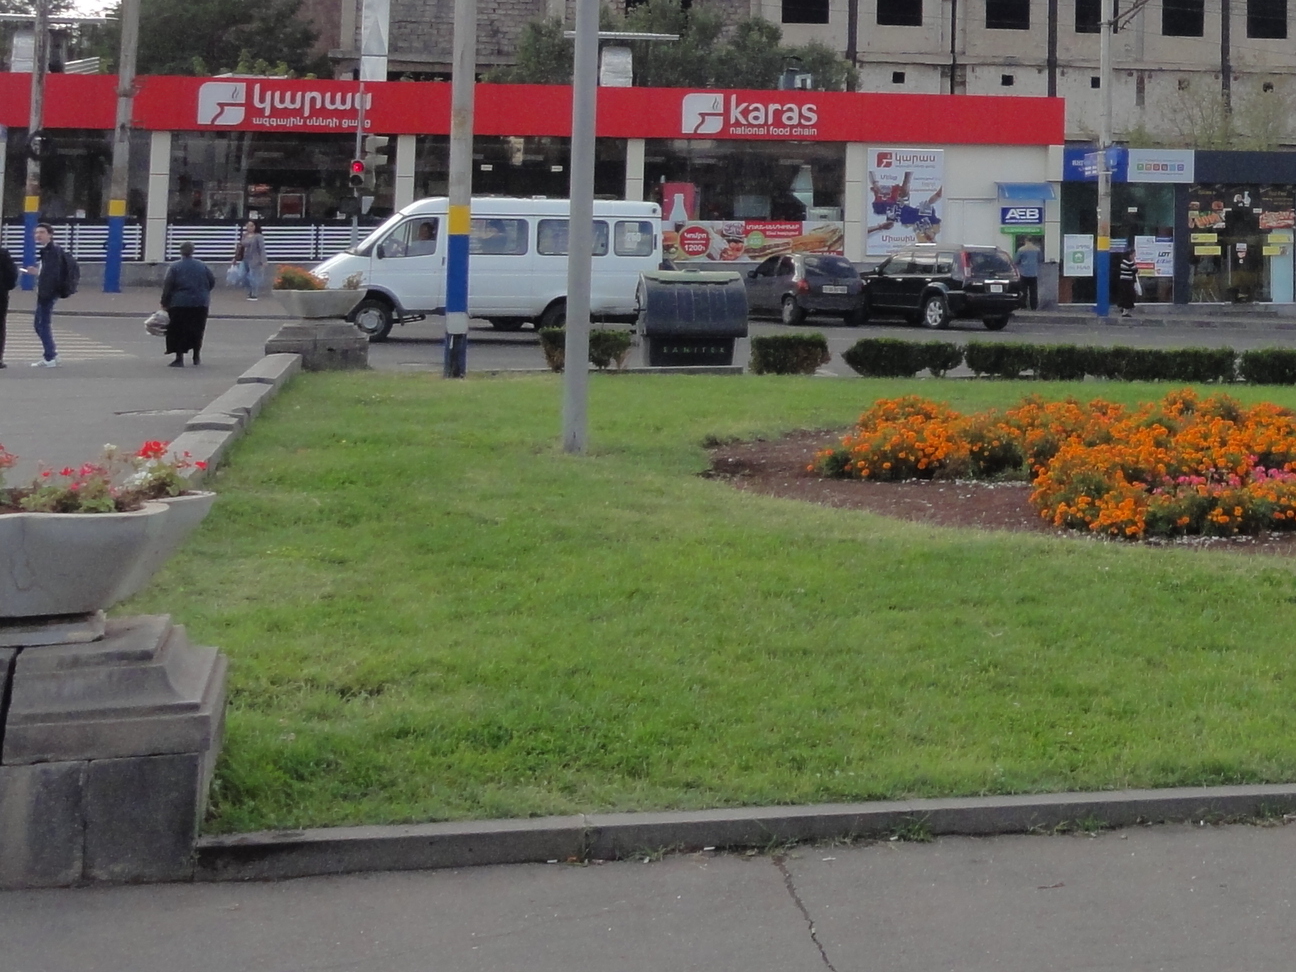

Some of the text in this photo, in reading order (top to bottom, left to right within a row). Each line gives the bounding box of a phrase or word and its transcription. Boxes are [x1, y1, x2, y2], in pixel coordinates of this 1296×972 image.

[253, 83, 372, 117] կարաս
[730, 94, 818, 125] karas
[252, 117, 371, 129] ազգային սննդի ցաց
[730, 126, 817, 136] national food chain
[895, 153, 936, 164] կարաս
[1005, 208, 1040, 219] AEB
[881, 235, 915, 243] Միասին
